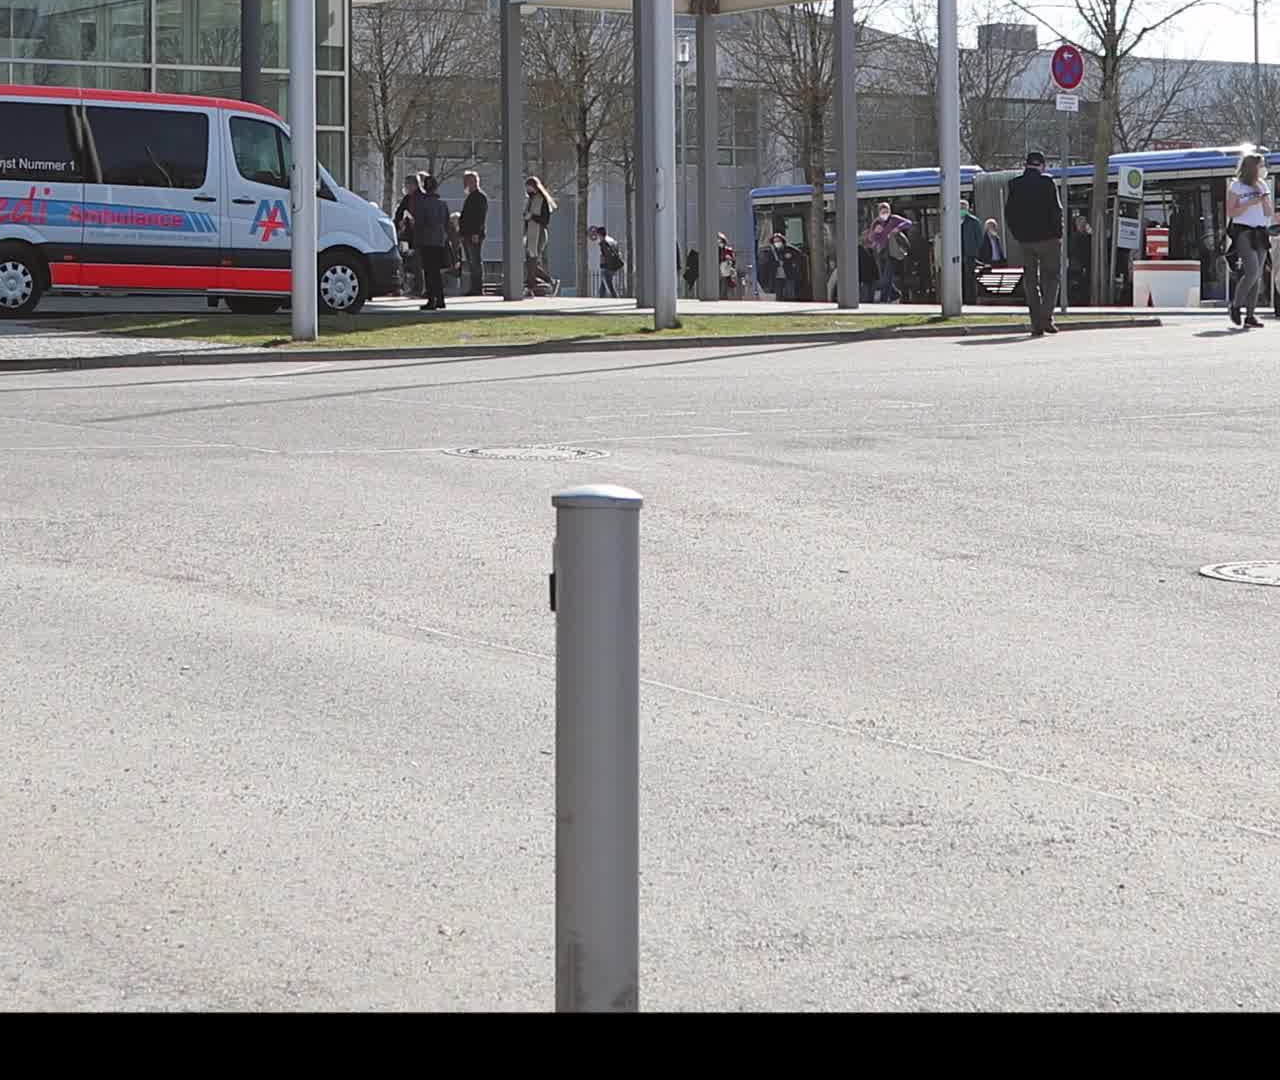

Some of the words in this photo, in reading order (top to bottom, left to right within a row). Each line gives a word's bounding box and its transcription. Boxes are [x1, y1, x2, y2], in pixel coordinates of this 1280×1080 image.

[19, 158, 66, 171] Nummer
[69, 161, 75, 171] 1
[68, 205, 184, 228] Ambulance
